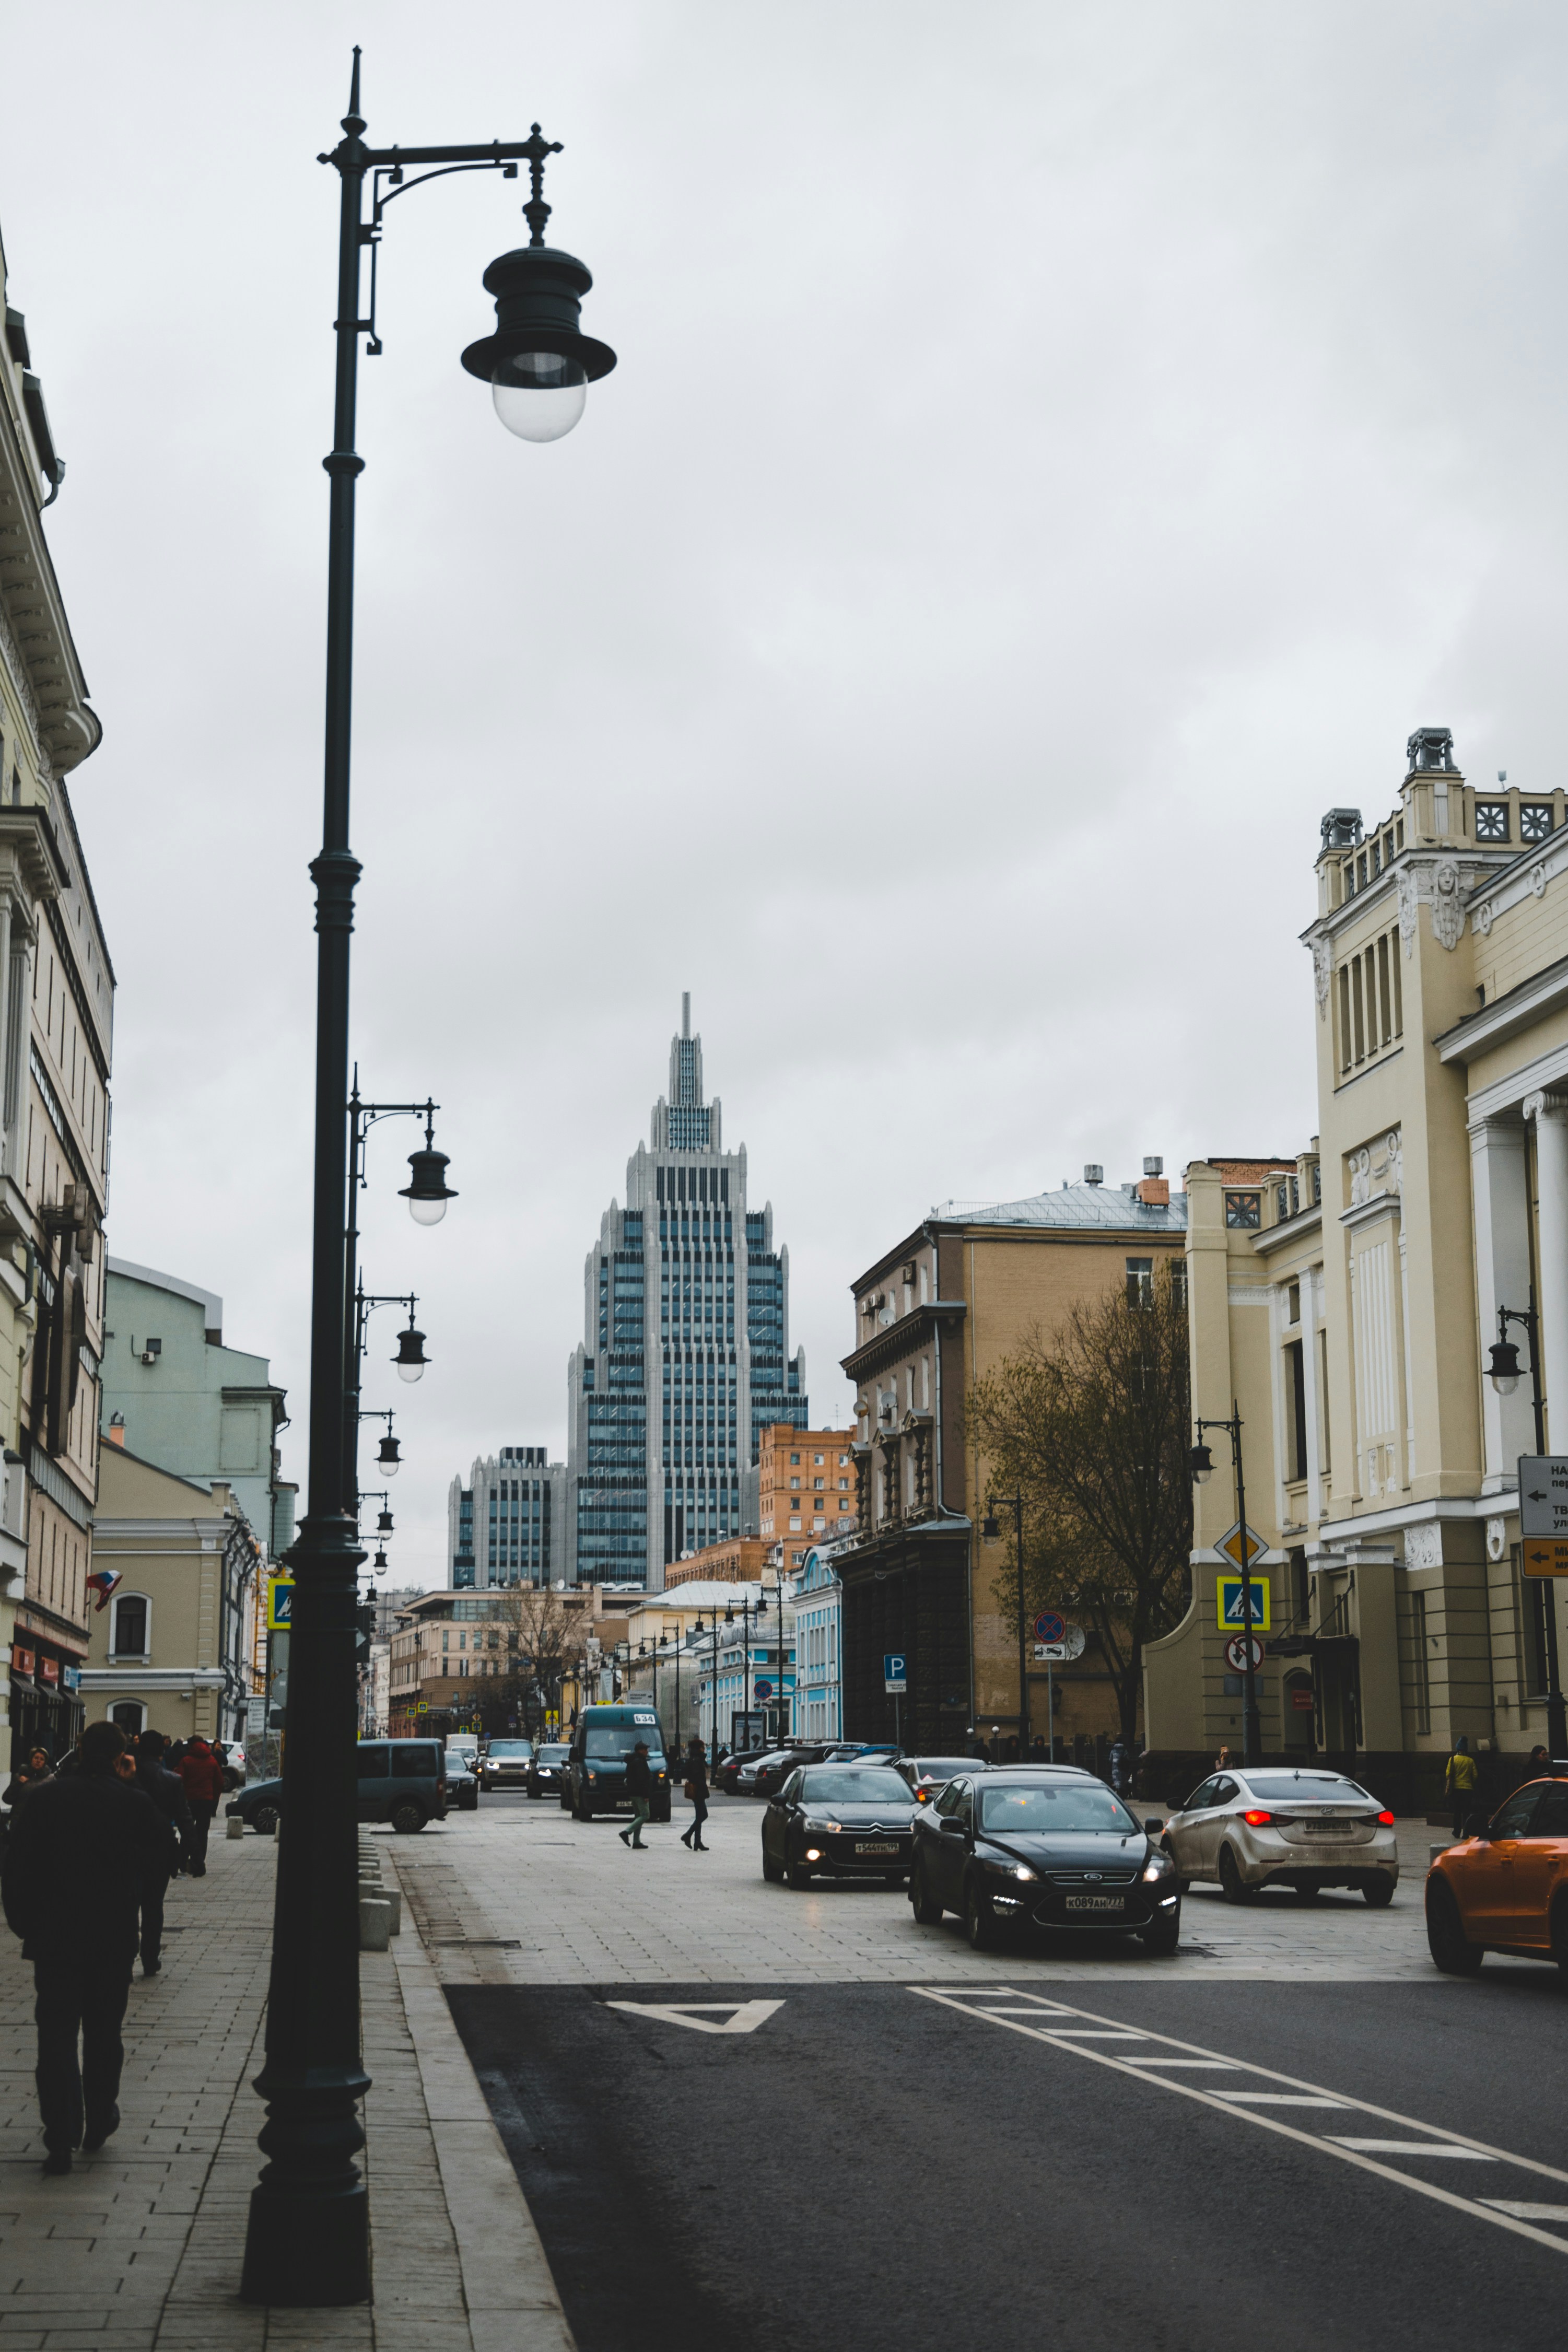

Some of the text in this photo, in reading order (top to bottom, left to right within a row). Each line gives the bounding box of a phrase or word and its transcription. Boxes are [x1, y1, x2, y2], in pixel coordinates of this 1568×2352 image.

[1551, 1466, 1568, 1475] НА
[1553, 1520, 1568, 1529] ул
[891, 1657, 904, 1677] P
